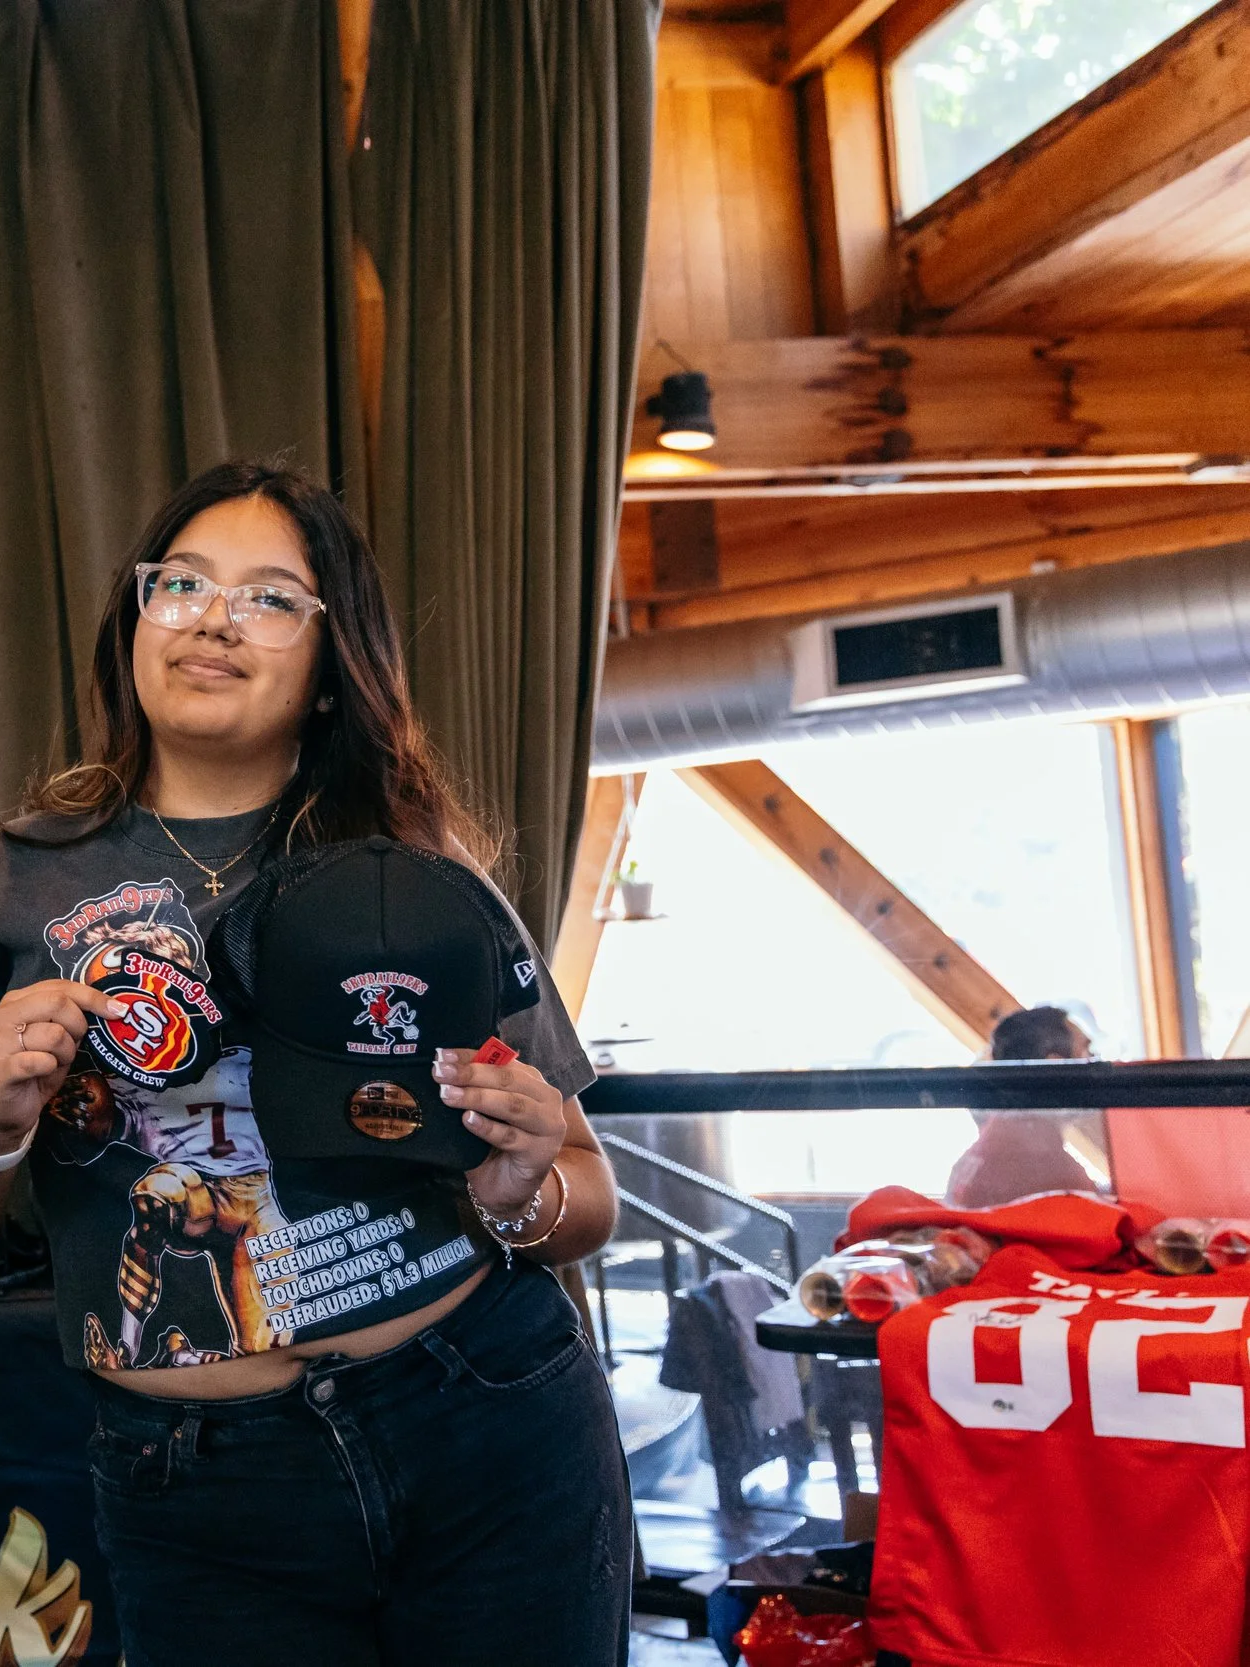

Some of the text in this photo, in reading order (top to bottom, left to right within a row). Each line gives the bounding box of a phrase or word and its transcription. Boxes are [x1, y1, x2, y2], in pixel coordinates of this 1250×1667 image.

[88, 1030, 167, 1088] TAILGATE CREW
[253, 1236, 348, 1283] RECEIVING
[419, 1234, 475, 1279] MILLION
[928, 1296, 1246, 1448] 82
